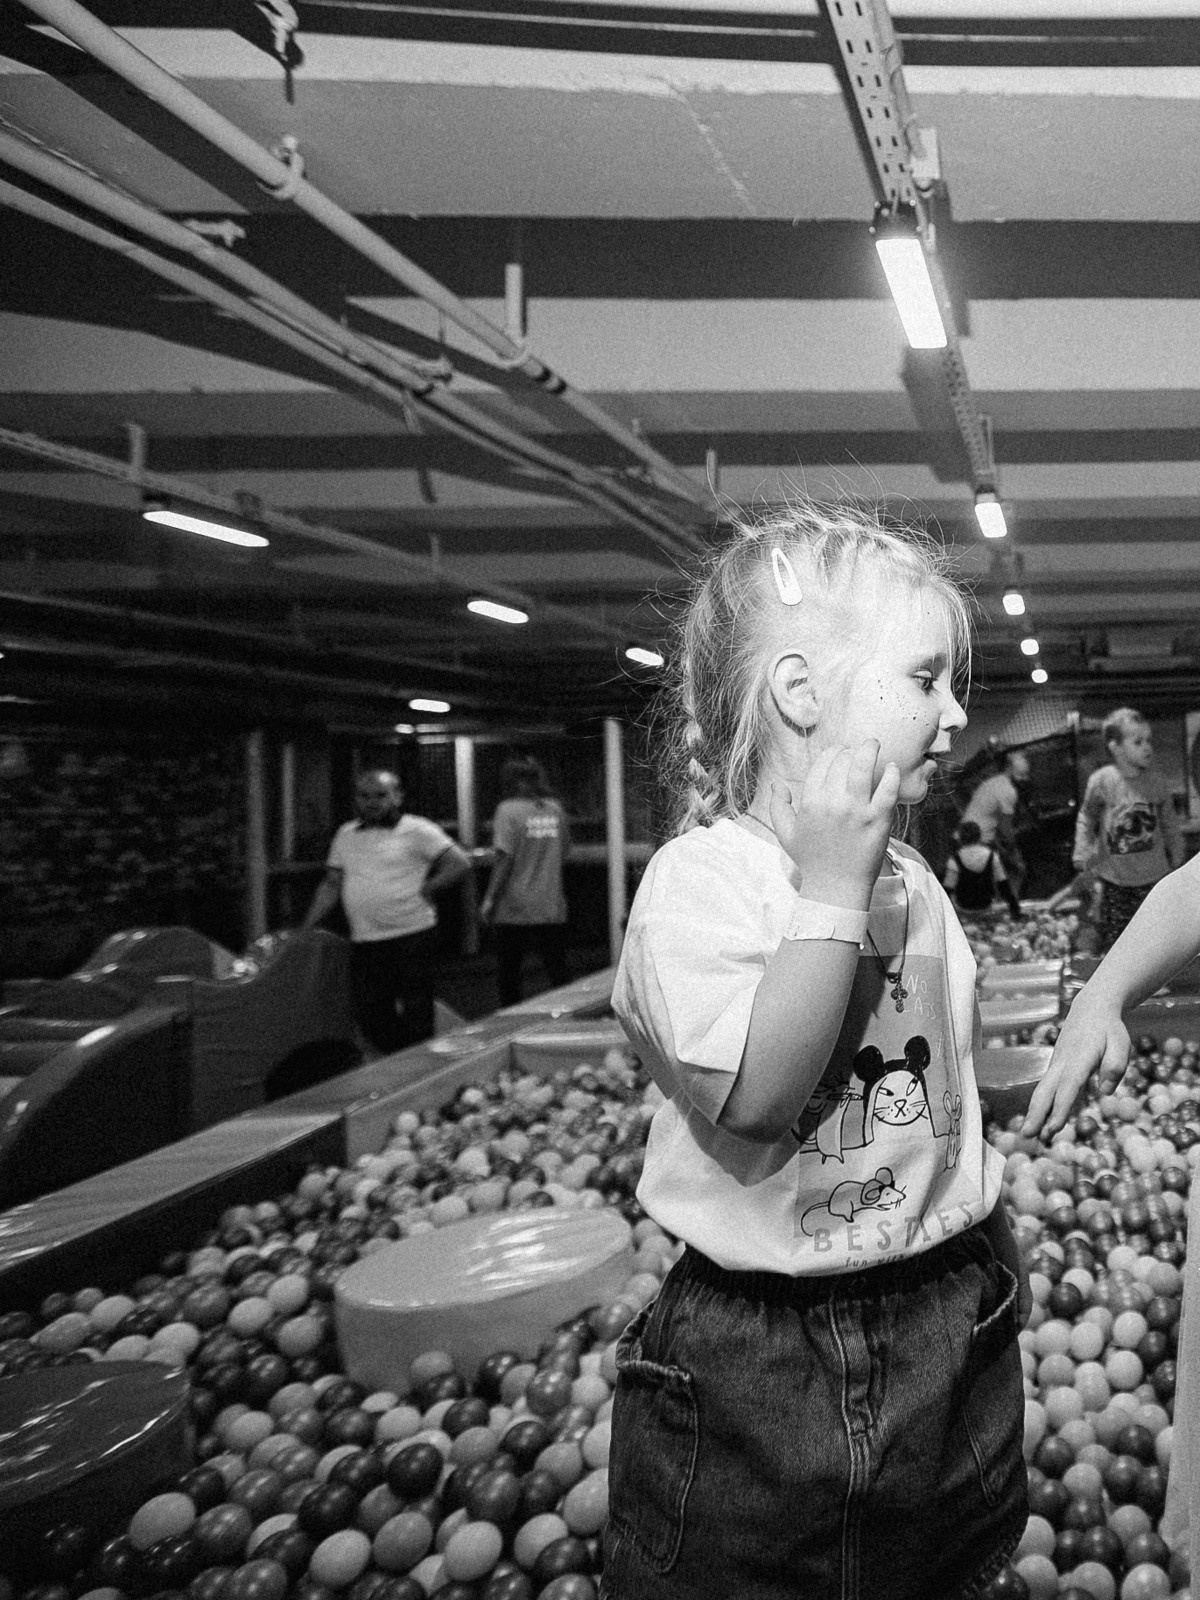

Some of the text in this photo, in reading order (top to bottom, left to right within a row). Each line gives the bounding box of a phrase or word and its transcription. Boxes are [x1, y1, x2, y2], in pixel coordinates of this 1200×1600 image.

[903, 996, 937, 1020] ATS
[813, 1200, 974, 1252] BESTIES
[845, 1256, 868, 1268] fun
